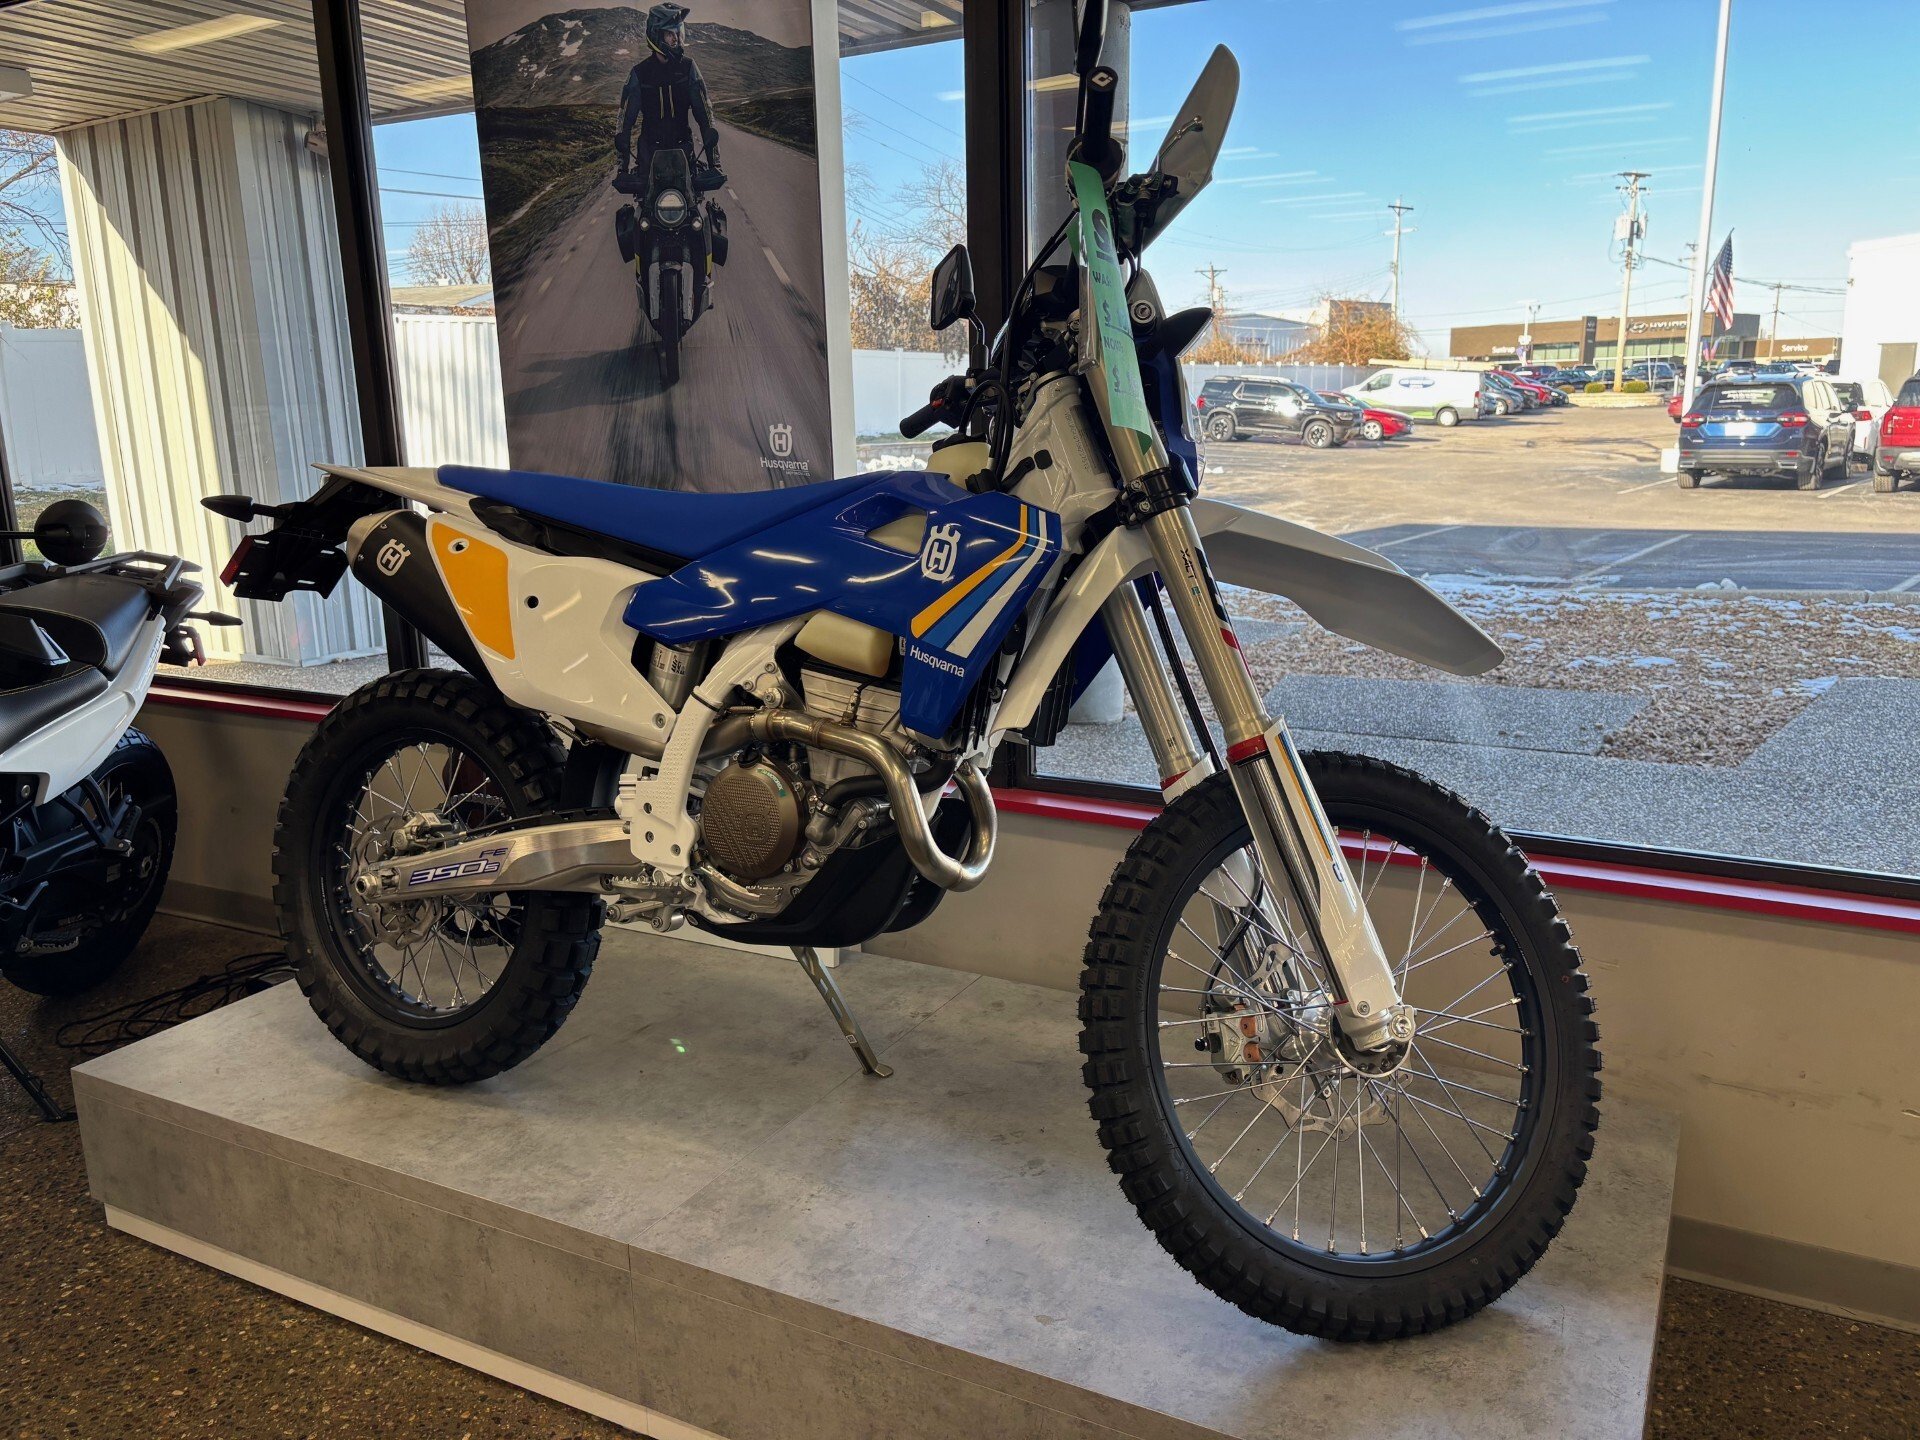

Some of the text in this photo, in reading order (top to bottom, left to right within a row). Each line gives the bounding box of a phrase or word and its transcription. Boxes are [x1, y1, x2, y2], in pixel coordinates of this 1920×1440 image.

[1781, 344, 1808, 352] Service
[760, 457, 809, 471] Husqvarna
[910, 644, 966, 678] Husqvarna
[479, 847, 509, 859] FE
